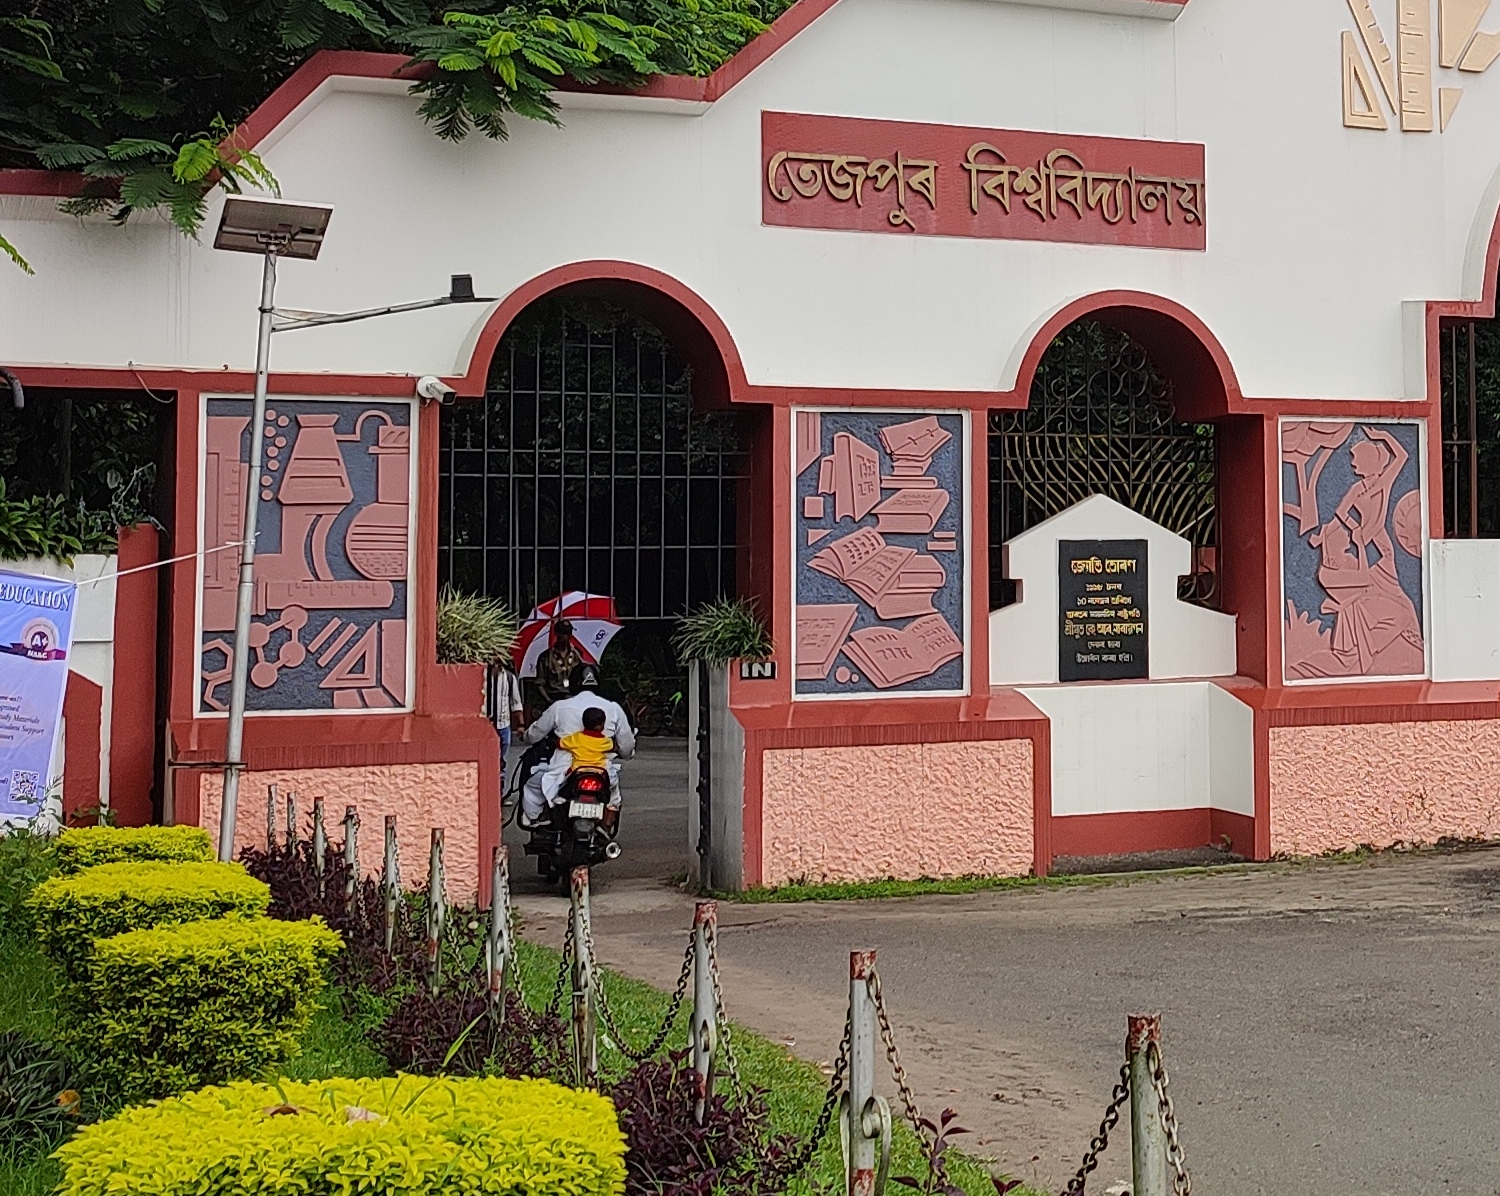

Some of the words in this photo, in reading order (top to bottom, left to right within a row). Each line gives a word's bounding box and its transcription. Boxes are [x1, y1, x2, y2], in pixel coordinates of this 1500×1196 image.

[767, 149, 939, 231] তেজপুৰ
[960, 142, 1205, 226] বিশ্ববিদ্যালয়
[0, 582, 71, 611] EDUCATION
[741, 662, 772, 678] IN
